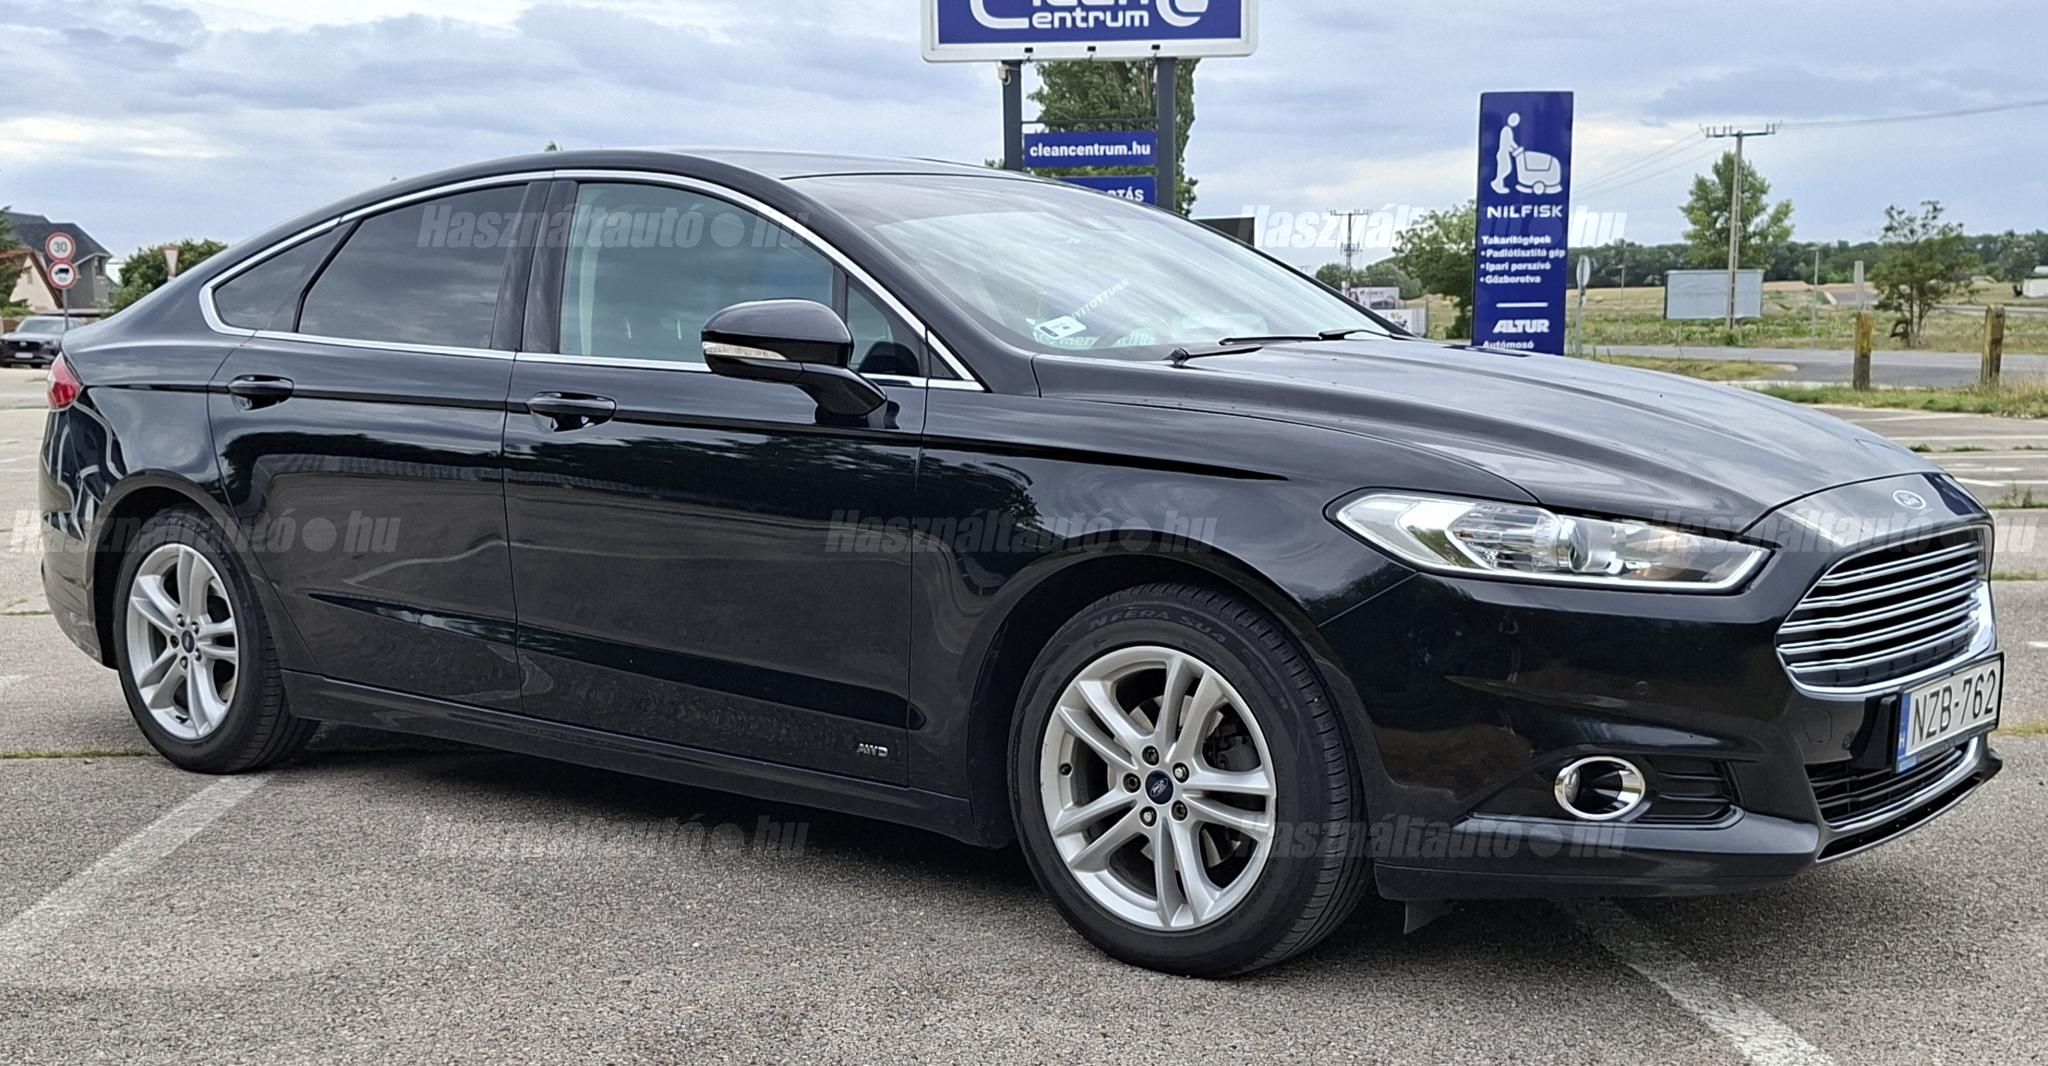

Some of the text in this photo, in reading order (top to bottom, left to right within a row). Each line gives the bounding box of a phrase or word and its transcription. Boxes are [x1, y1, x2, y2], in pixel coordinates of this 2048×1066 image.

[1029, 141, 1151, 157] cleancentrum.hu
[1486, 204, 1563, 219] NILFISK
[54, 241, 68, 253] 30
[1485, 261, 1509, 272] Ipari
[1492, 319, 1550, 334] ALTUR
[1912, 669, 1996, 746] NZB-762
[857, 743, 888, 757] AWD
